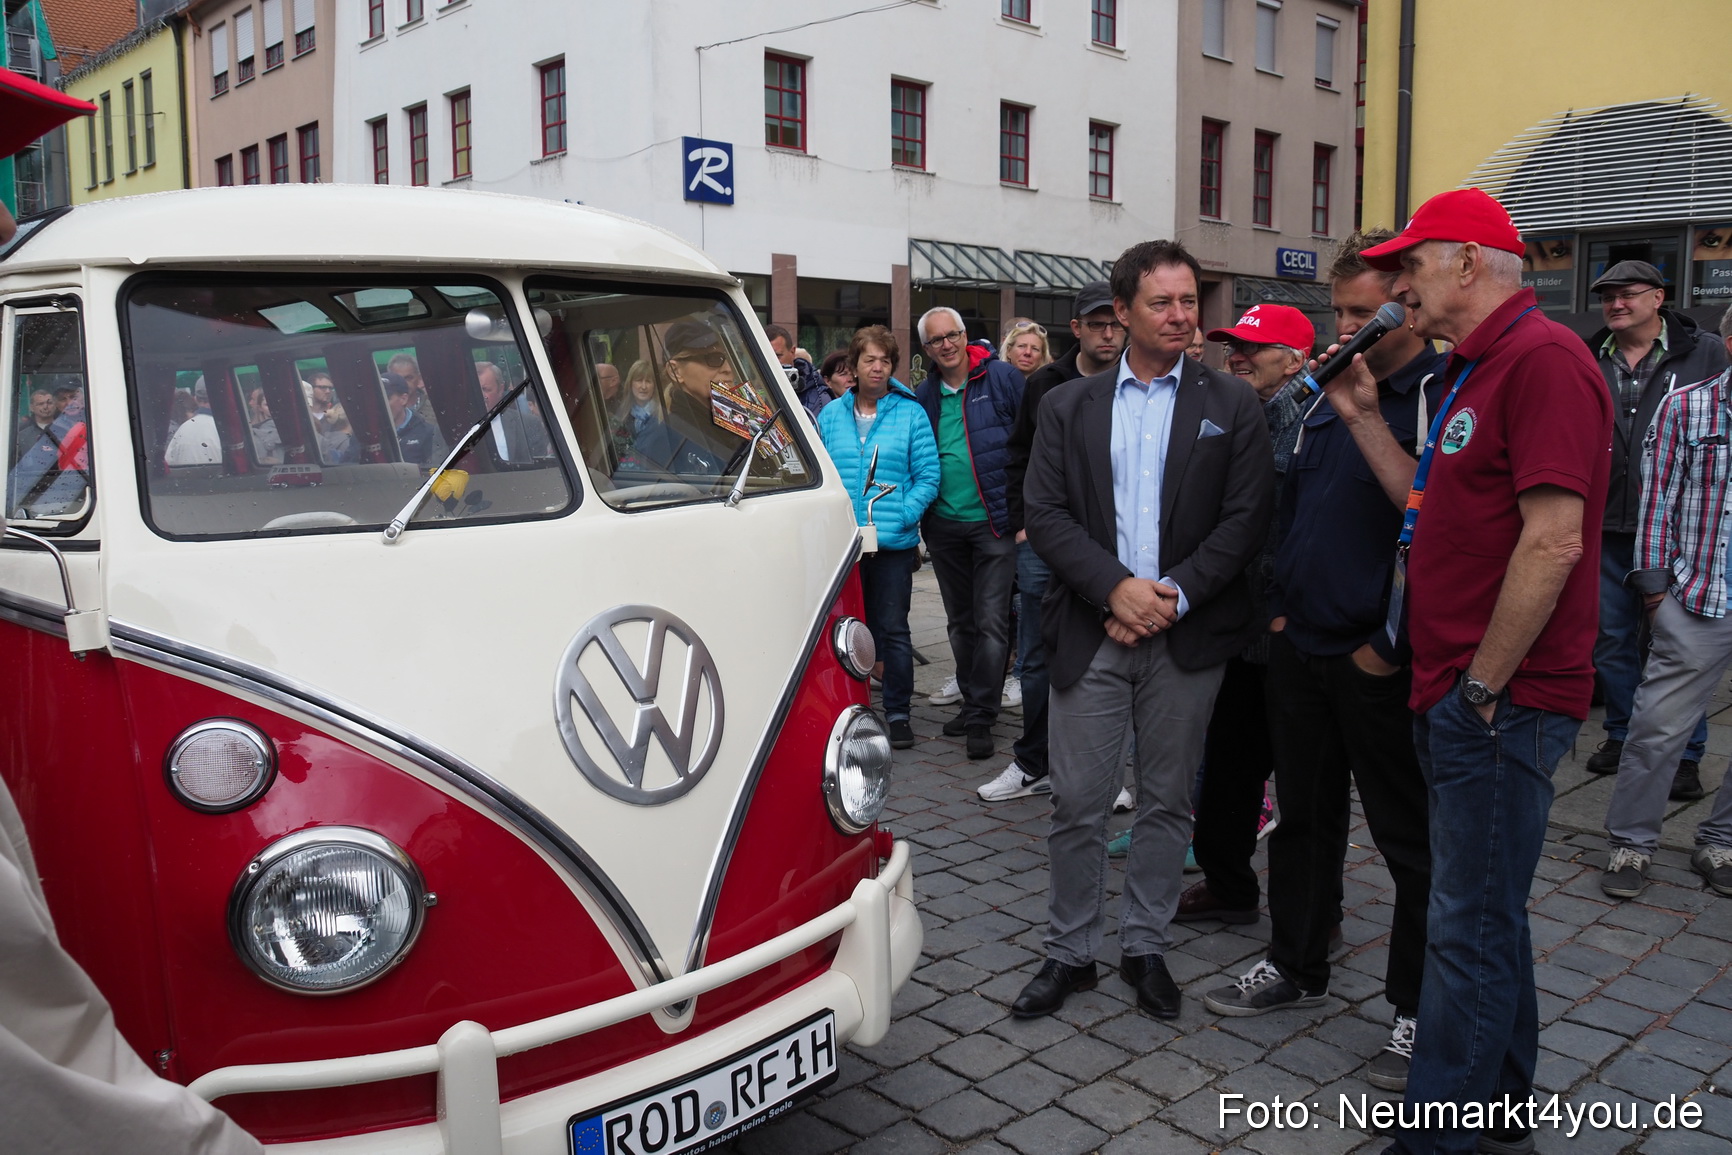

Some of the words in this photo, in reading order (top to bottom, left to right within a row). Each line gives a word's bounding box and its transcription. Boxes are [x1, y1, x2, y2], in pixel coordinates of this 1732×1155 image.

[1282, 250, 1315, 270] CECIL
[1537, 277, 1562, 287] Bilder
[1236, 315, 1260, 328] EKRA
[556, 606, 724, 806] VW
[605, 1089, 700, 1155] ROD
[679, 1144, 706, 1155] utos
[708, 1128, 739, 1149] haben
[741, 1115, 767, 1133] keine
[769, 1100, 793, 1118] Seele
